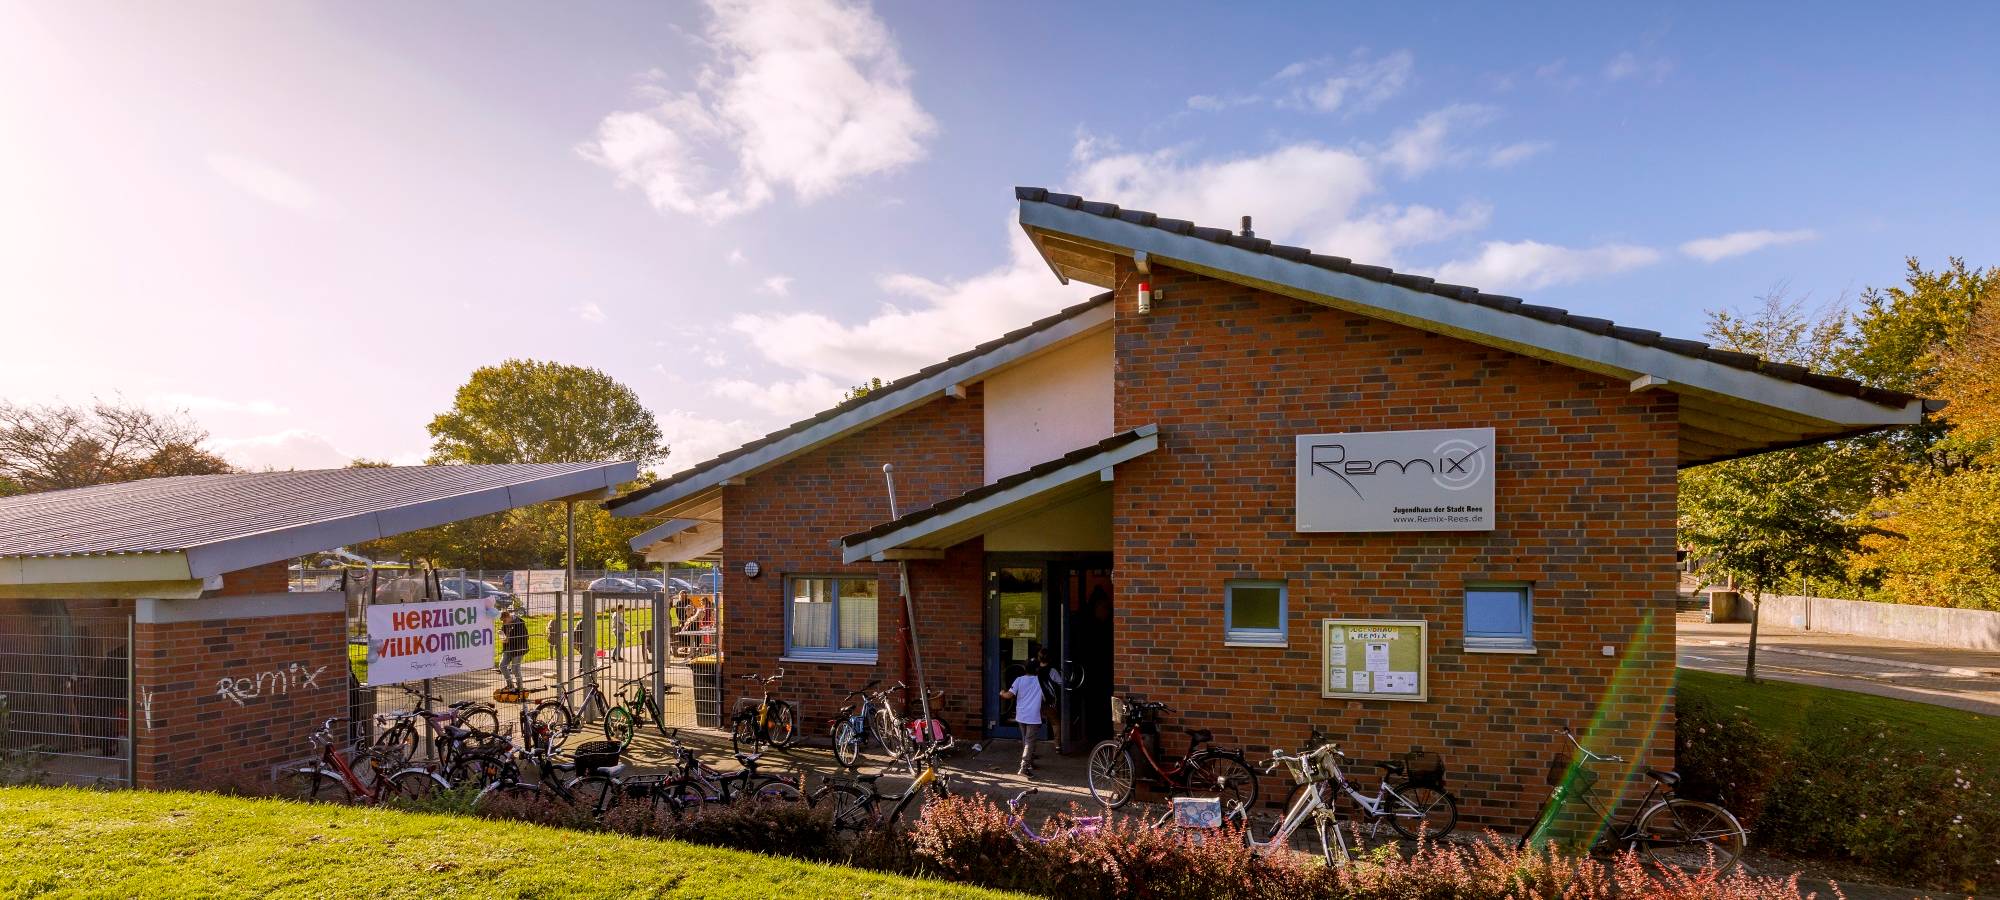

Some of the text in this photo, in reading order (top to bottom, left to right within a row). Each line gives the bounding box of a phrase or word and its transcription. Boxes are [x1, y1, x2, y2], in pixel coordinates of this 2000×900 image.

[1392, 505, 1483, 514] Jugendhaus der Stadt Rees
[1392, 515, 1483, 523] www.Remix-Rees.de
[216, 662, 327, 708] Remix
